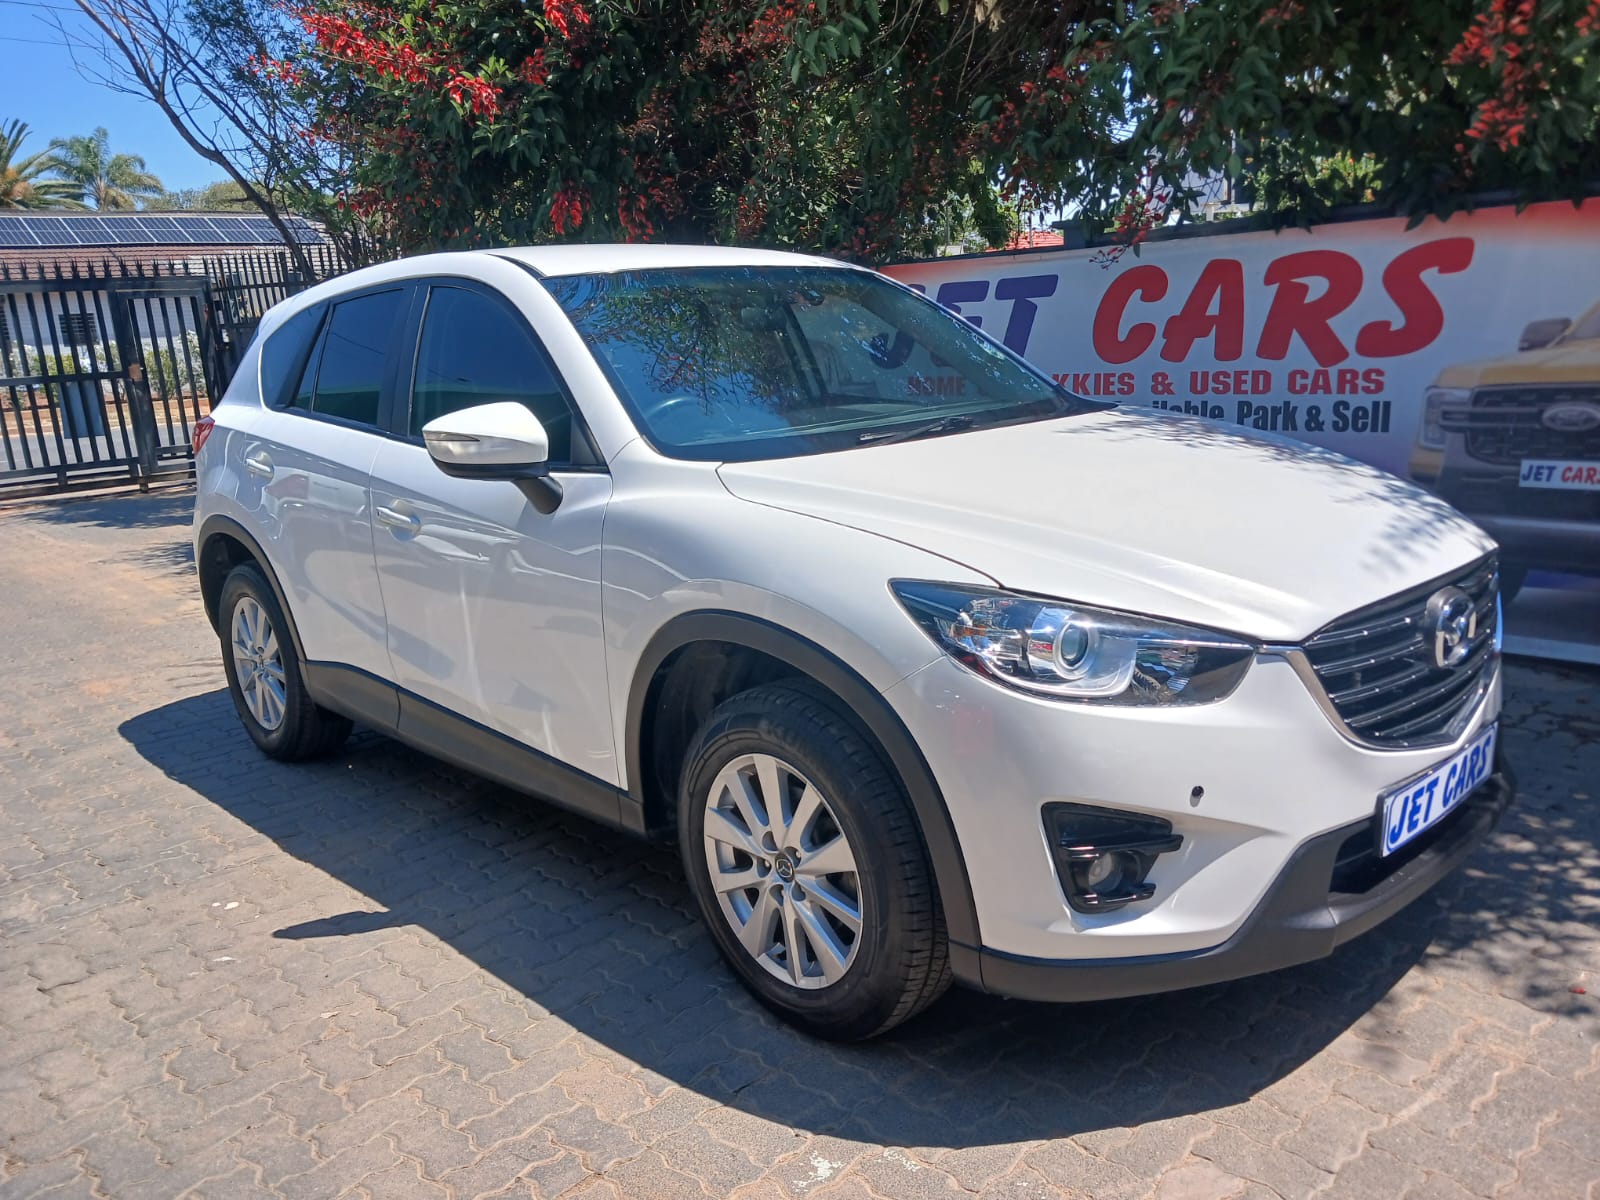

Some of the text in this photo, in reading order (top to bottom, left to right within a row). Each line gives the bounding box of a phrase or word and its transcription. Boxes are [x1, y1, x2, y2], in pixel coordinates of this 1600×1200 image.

[1092, 237, 1476, 368] CARS
[1151, 371, 1176, 396] &
[1190, 370, 1272, 396] USED
[1287, 368, 1386, 396] CARS
[1237, 400, 1299, 432] Park
[1304, 405, 1326, 432] &
[1332, 400, 1392, 433] Sell
[1521, 464, 1557, 482] JET
[1389, 735, 1492, 845] JET CARS
